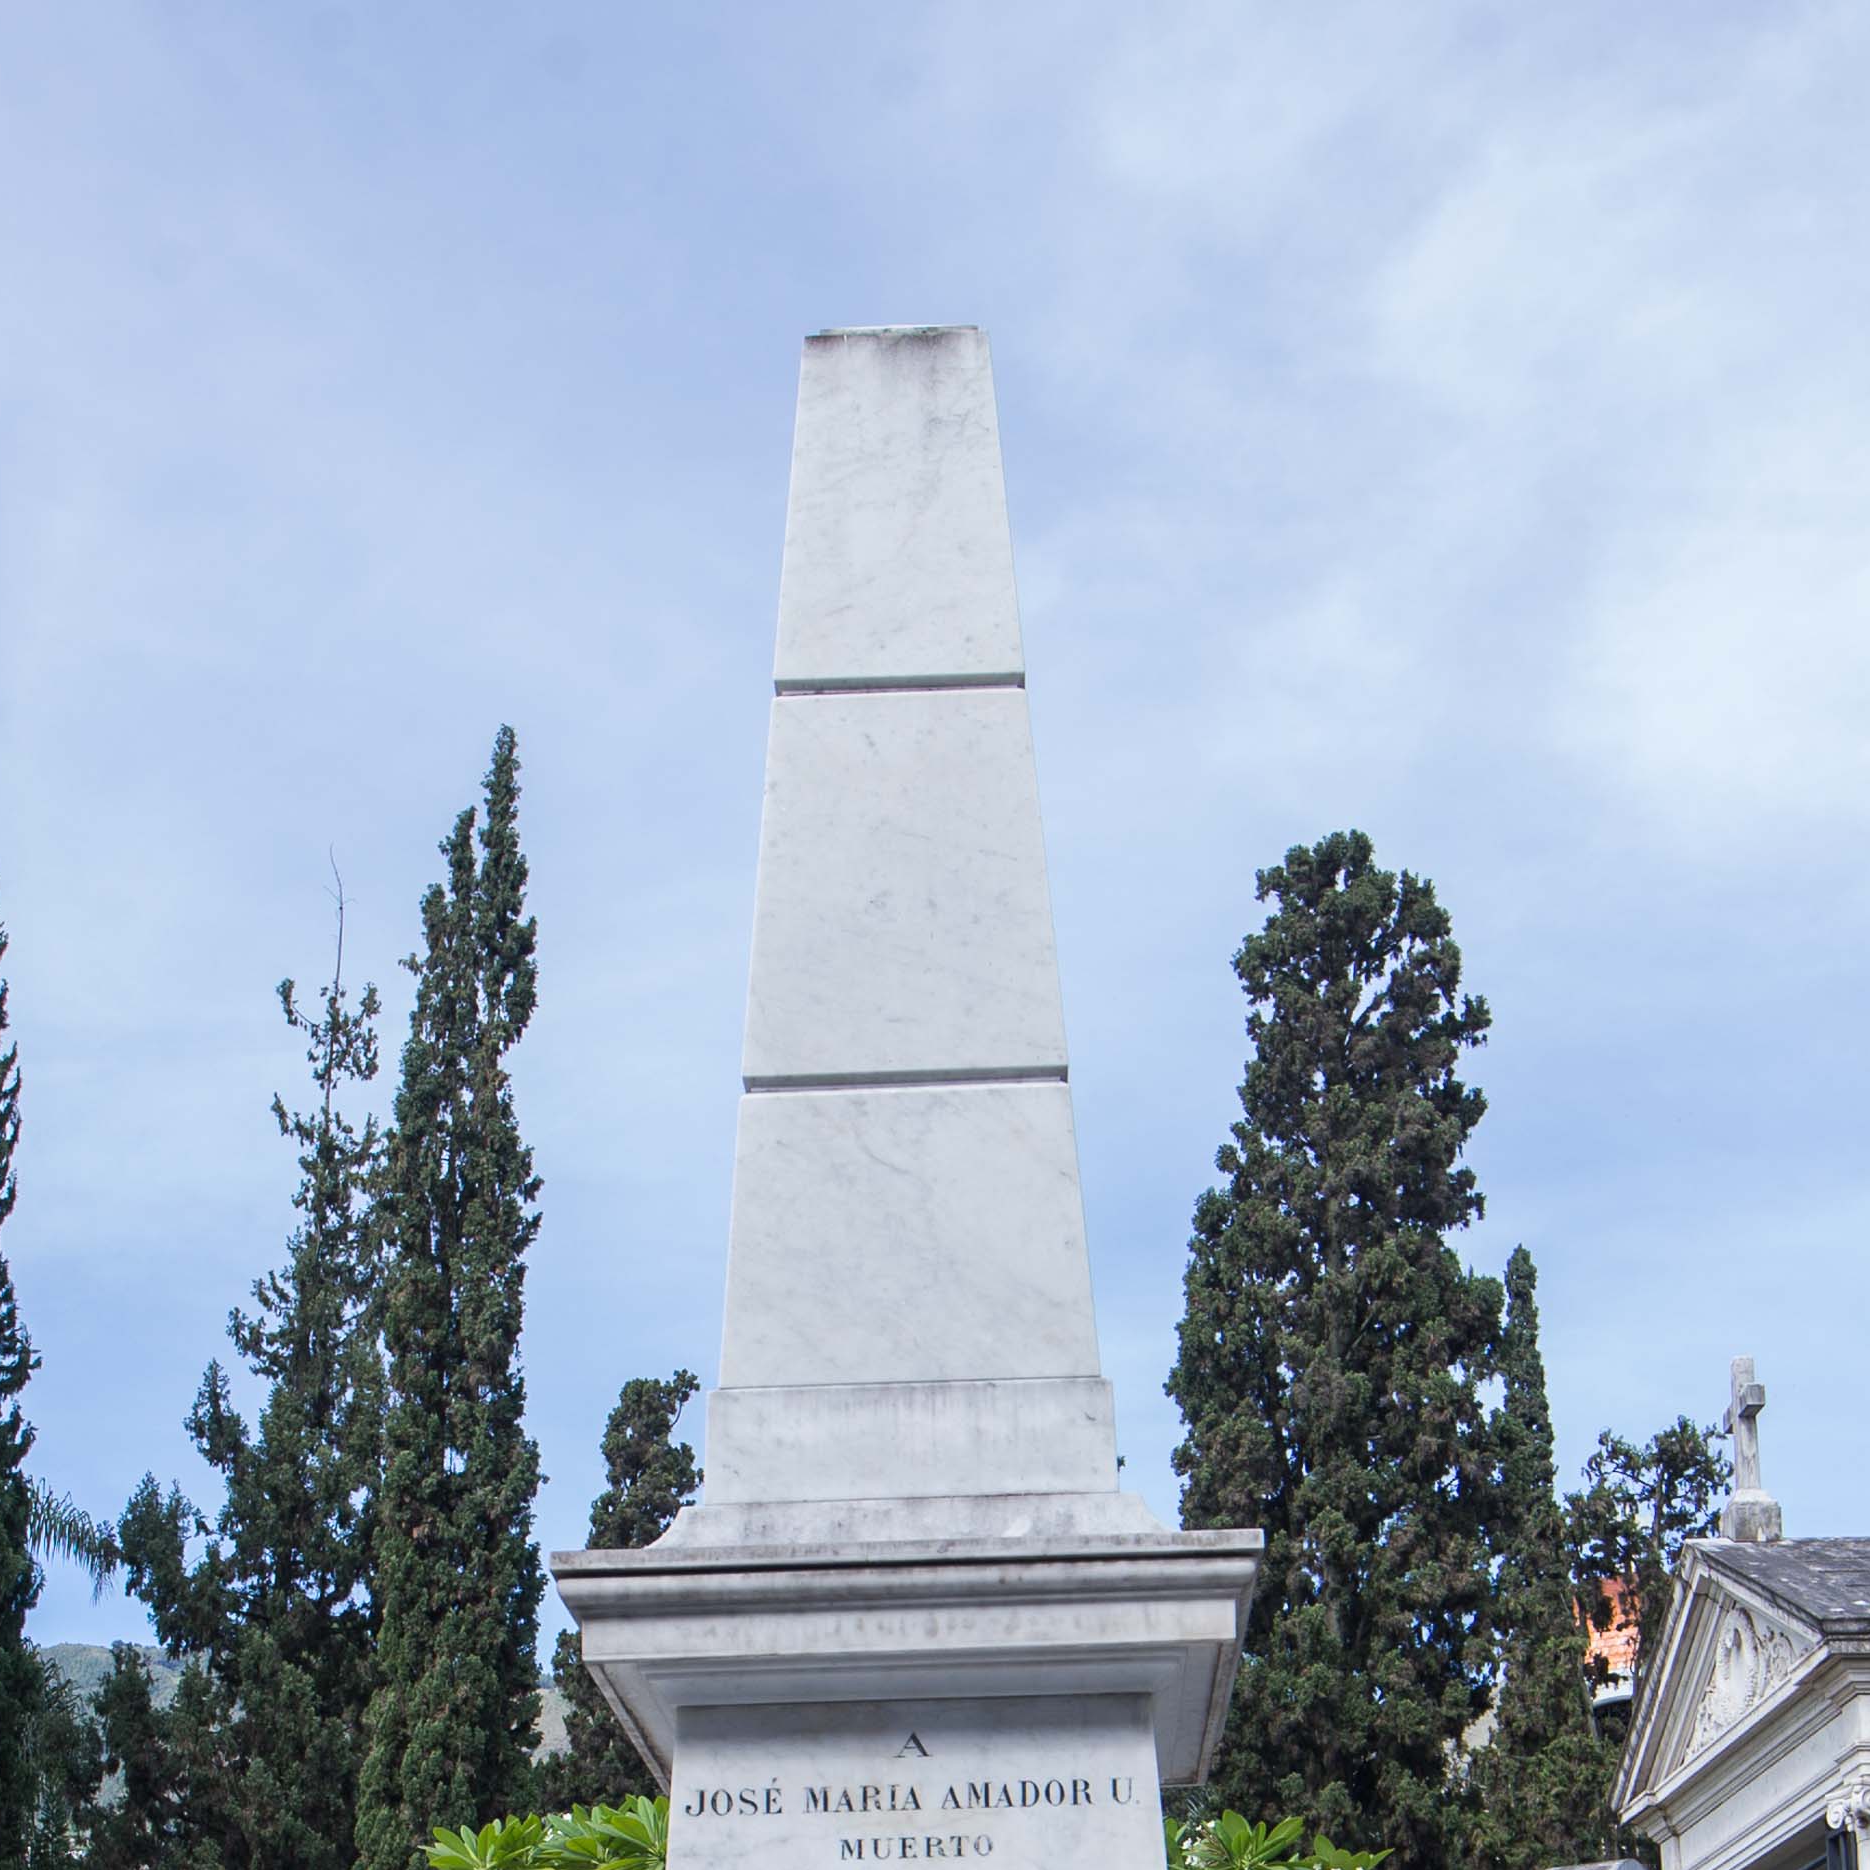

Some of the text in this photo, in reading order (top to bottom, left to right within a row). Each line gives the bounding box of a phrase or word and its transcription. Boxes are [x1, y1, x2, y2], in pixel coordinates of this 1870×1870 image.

[893, 1731, 933, 1759] A
[684, 1776, 784, 1817] JOSÉ
[940, 1778, 1095, 1810] AMADOR
[839, 1834, 995, 1861] MUERTO
